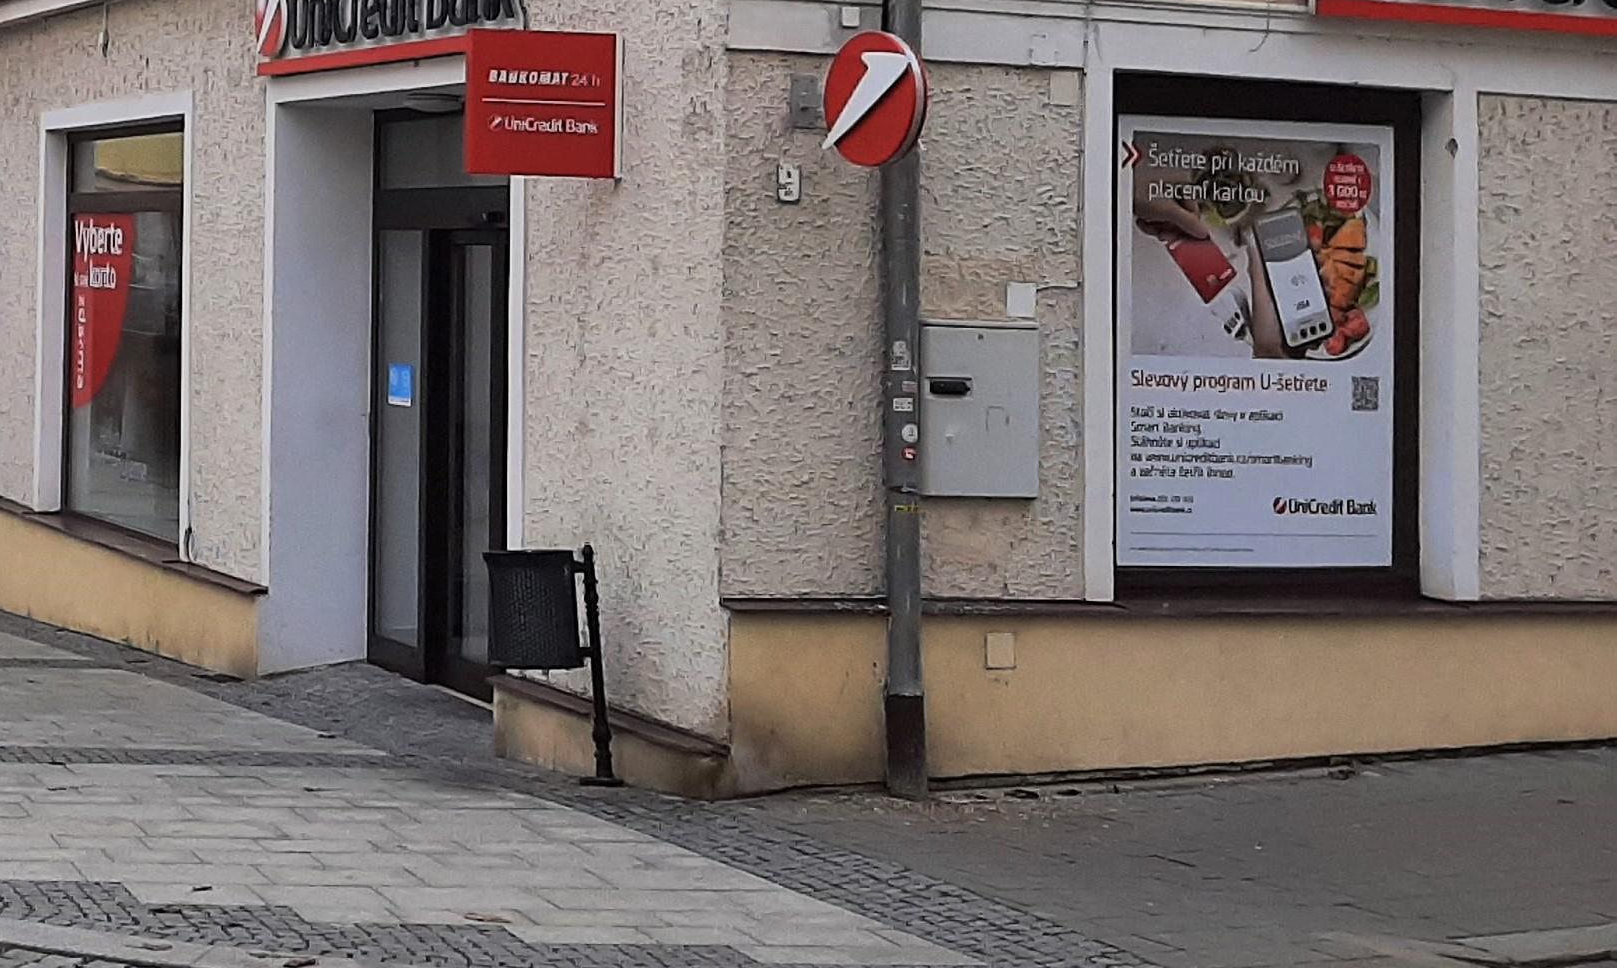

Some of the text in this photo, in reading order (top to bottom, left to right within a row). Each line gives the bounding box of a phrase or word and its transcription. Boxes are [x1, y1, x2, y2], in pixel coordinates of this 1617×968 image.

[488, 69, 569, 86] BANKOMAT
[571, 73, 589, 87] 24
[504, 115, 599, 134] UniCredit Bank
[1148, 142, 1300, 175] Šetřete při každém
[1148, 179, 1265, 203] placení kartou
[75, 218, 123, 263] Vyberte
[89, 259, 117, 289] konto
[1131, 369, 1328, 393] Slevový program U-šetřete
[1288, 498, 1378, 516] UniCredit Bank
